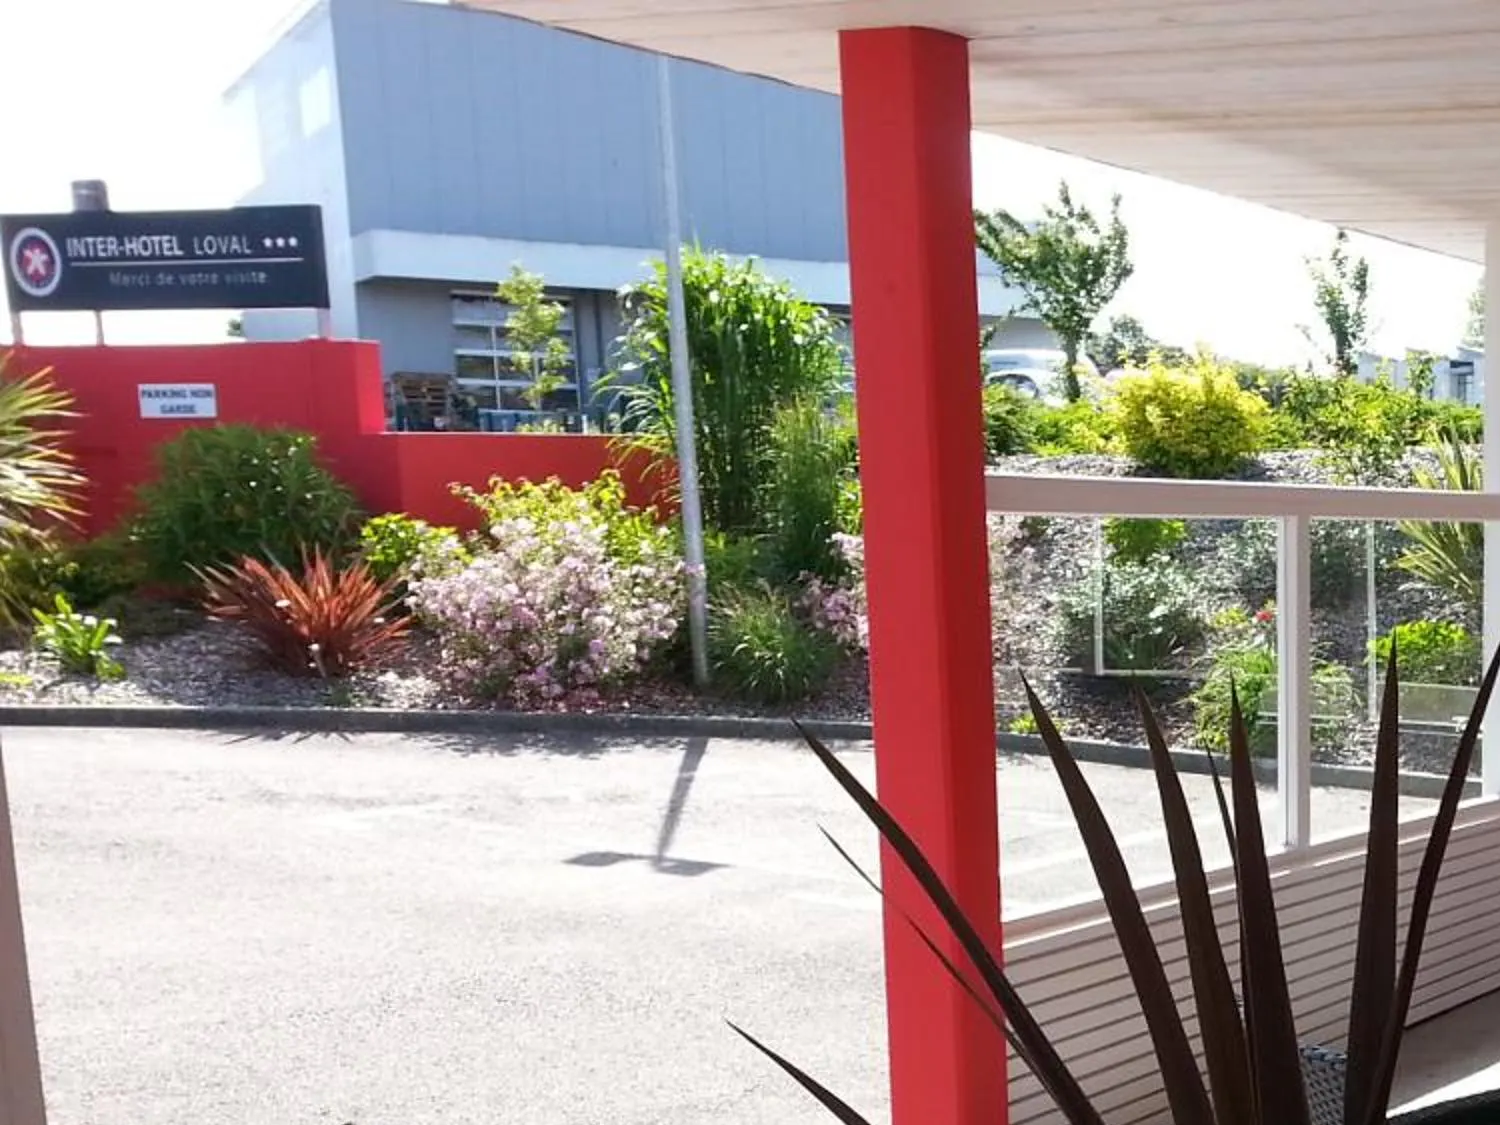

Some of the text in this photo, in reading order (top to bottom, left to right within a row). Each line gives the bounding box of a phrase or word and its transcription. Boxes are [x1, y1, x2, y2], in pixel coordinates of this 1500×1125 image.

[66, 235, 252, 257] INTER-HOTEL LOVAL
[109, 271, 150, 287] Merci
[156, 271, 174, 286] de
